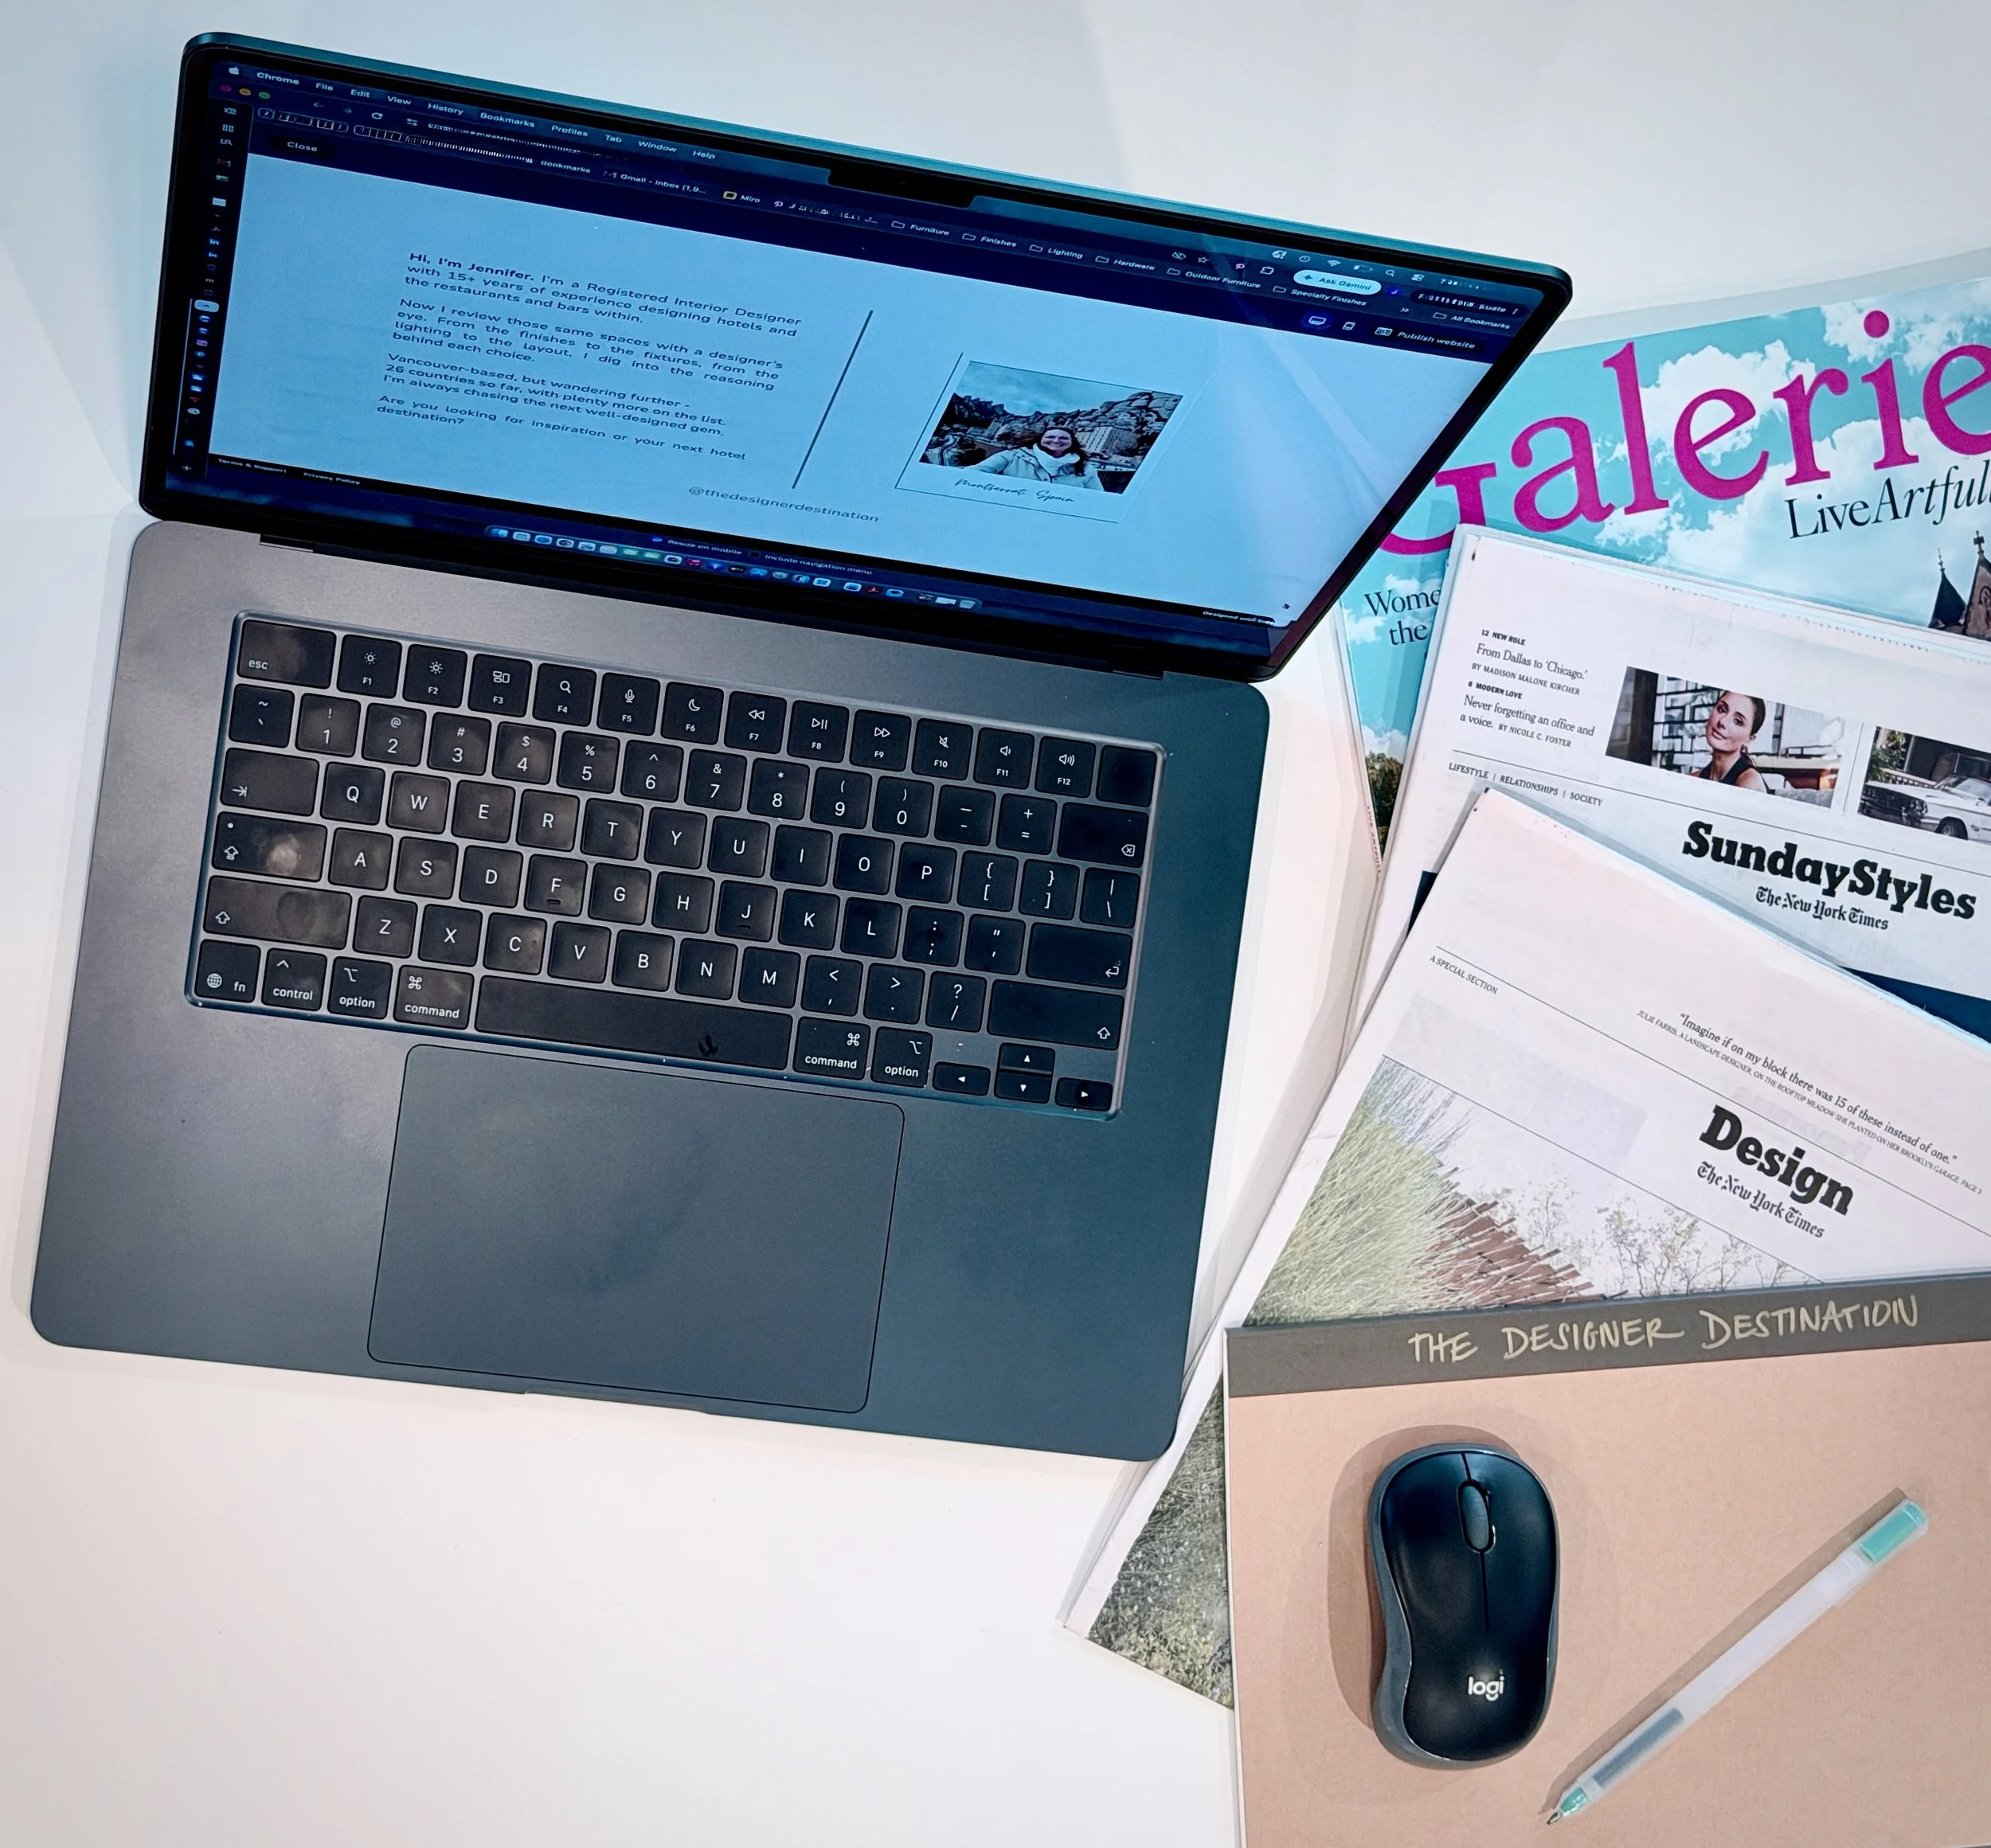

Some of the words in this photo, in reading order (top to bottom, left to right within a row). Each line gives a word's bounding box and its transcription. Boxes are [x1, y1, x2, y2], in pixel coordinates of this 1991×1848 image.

[256, 72, 299, 85] Chrome
[350, 89, 370, 98] Edit
[387, 95, 412, 105] View
[428, 103, 464, 115] History
[479, 113, 535, 127] Bookmarks
[551, 125, 588, 138] Profiles
[605, 135, 622, 143] Tab
[638, 141, 677, 153] Window
[693, 150, 715, 159] Help
[288, 141, 318, 153] Close
[1186, 271, 1221, 283] Outdoor
[1222, 279, 1261, 289] Furniture
[1319, 277, 1336, 286] Ask
[1339, 281, 1371, 291] Gemini
[405, 276, 429, 287] the
[433, 282, 519, 303] restaurants
[525, 296, 553, 308] and
[557, 302, 589, 315] bars
[595, 309, 643, 324] within.
[438, 258, 461, 268] I'm
[467, 264, 534, 280] Jennifer.
[542, 275, 563, 285] I'm
[587, 283, 667, 303] Registered
[675, 298, 728, 314] Interior
[735, 308, 801, 326] Designer
[407, 266, 440, 277] with
[448, 272, 475, 282] 15+
[483, 279, 523, 291] years
[530, 286, 546, 295] of
[551, 290, 632, 309] experience
[639, 304, 710, 324] designing
[717, 317, 762, 331] hotels
[769, 326, 796, 338] and
[1398, 331, 1434, 343] Publish
[1437, 337, 1475, 349] website
[522, 375, 546, 386] but
[550, 381, 626, 400] wandering
[631, 393, 681, 408] further
[377, 405, 465, 425] destination?
[379, 395, 405, 405] Are
[413, 400, 438, 410] you
[445, 405, 497, 421] looking
[504, 415, 525, 424] for
[531, 420, 606, 438] inspiration
[613, 433, 628, 442] or
[635, 436, 666, 447] your
[672, 443, 703, 454] next
[710, 447, 746, 461] hotel
[689, 486, 878, 522] @thedesignerdestination
[1389, 620, 1430, 645] the
[1492, 631, 1508, 642] NEW
[1508, 635, 1526, 646] ROLE
[248, 658, 268, 671] esc
[1477, 643, 1500, 659] From
[1503, 650, 1531, 666] Dallas
[1534, 659, 1543, 669] to
[362, 677, 372, 686] F1
[1472, 662, 1481, 671] BY
[1484, 666, 1516, 679] MADISON
[1518, 674, 1547, 688] MALONE
[1550, 682, 1580, 695] KIRCHER
[428, 686, 438, 695] F2
[1476, 682, 1504, 695] MODERN
[1505, 690, 1523, 700] LOVE
[493, 696, 503, 705] F3
[557, 705, 568, 714] F4
[621, 714, 632, 723] F5
[1464, 694, 1492, 712] Never
[1494, 703, 1536, 724] forgetting
[1538, 715, 1549, 726] an
[1551, 717, 1575, 732] office
[1577, 725, 1595, 736] and
[685, 723, 696, 732] F6
[1469, 717, 1494, 730] voice.
[1510, 725, 1535, 739] NICOLE
[1545, 735, 1571, 748] FOSTER
[749, 733, 759, 741] F7
[812, 741, 822, 750] F8
[874, 750, 884, 759] F9
[933, 760, 948, 769] F10
[996, 768, 1008, 777] F11
[1058, 777, 1070, 786] F12
[1449, 763, 1488, 779] LIFESTYLE
[1500, 775, 1559, 795] RELATIONSHIPS
[1569, 791, 1602, 807] SOCIETY
[1435, 957, 1467, 979] SPECIAL
[1466, 973, 1499, 994] SECTION
[233, 981, 245, 993] fn
[273, 987, 314, 1002] control
[339, 995, 375, 1010] option
[405, 1003, 460, 1019] command
[804, 1054, 858, 1070] command
[884, 1065, 919, 1079] option
[1637, 1010, 1656, 1024] JULIE
[1684, 1035, 1721, 1058] LANDSCAPE
[1753, 1071, 1764, 1080] ON
[1764, 1076, 1777, 1088] THE
[1777, 1084, 1807, 1102] ROOFTOP
[1806, 1099, 1835, 1118] MEADOW
[1835, 1113, 1848, 1125] SHE
[1848, 1121, 1877, 1139] PLANTED
[1876, 1134, 1887, 1143] ON
[1887, 1139, 1900, 1151] HER
[1899, 1147, 1934, 1170] BROOKLYN
[1960, 1179, 1978, 1192] PAGE
[1722, 1036, 1732, 1048] if
[1731, 1044, 1744, 1056] on
[1746, 1051, 1762, 1065] my
[1762, 1057, 1788, 1079] block
[1788, 1072, 1814, 1092] there
[1815, 1088, 1833, 1102] was
[1834, 1095, 1848, 1108] 15
[1847, 1104, 1860, 1115] of
[1858, 1109, 1883, 1129] these
[1883, 1122, 1920, 1147] instead
[1919, 1143, 1933, 1154] of
[1699, 1104, 1854, 1217] Design
[1408, 1330, 1479, 1364] THE
[1501, 1316, 1684, 1362] DESIGNER
[1700, 1294, 1919, 1351] DESTINATION
[1467, 1676, 1504, 1702] logi
